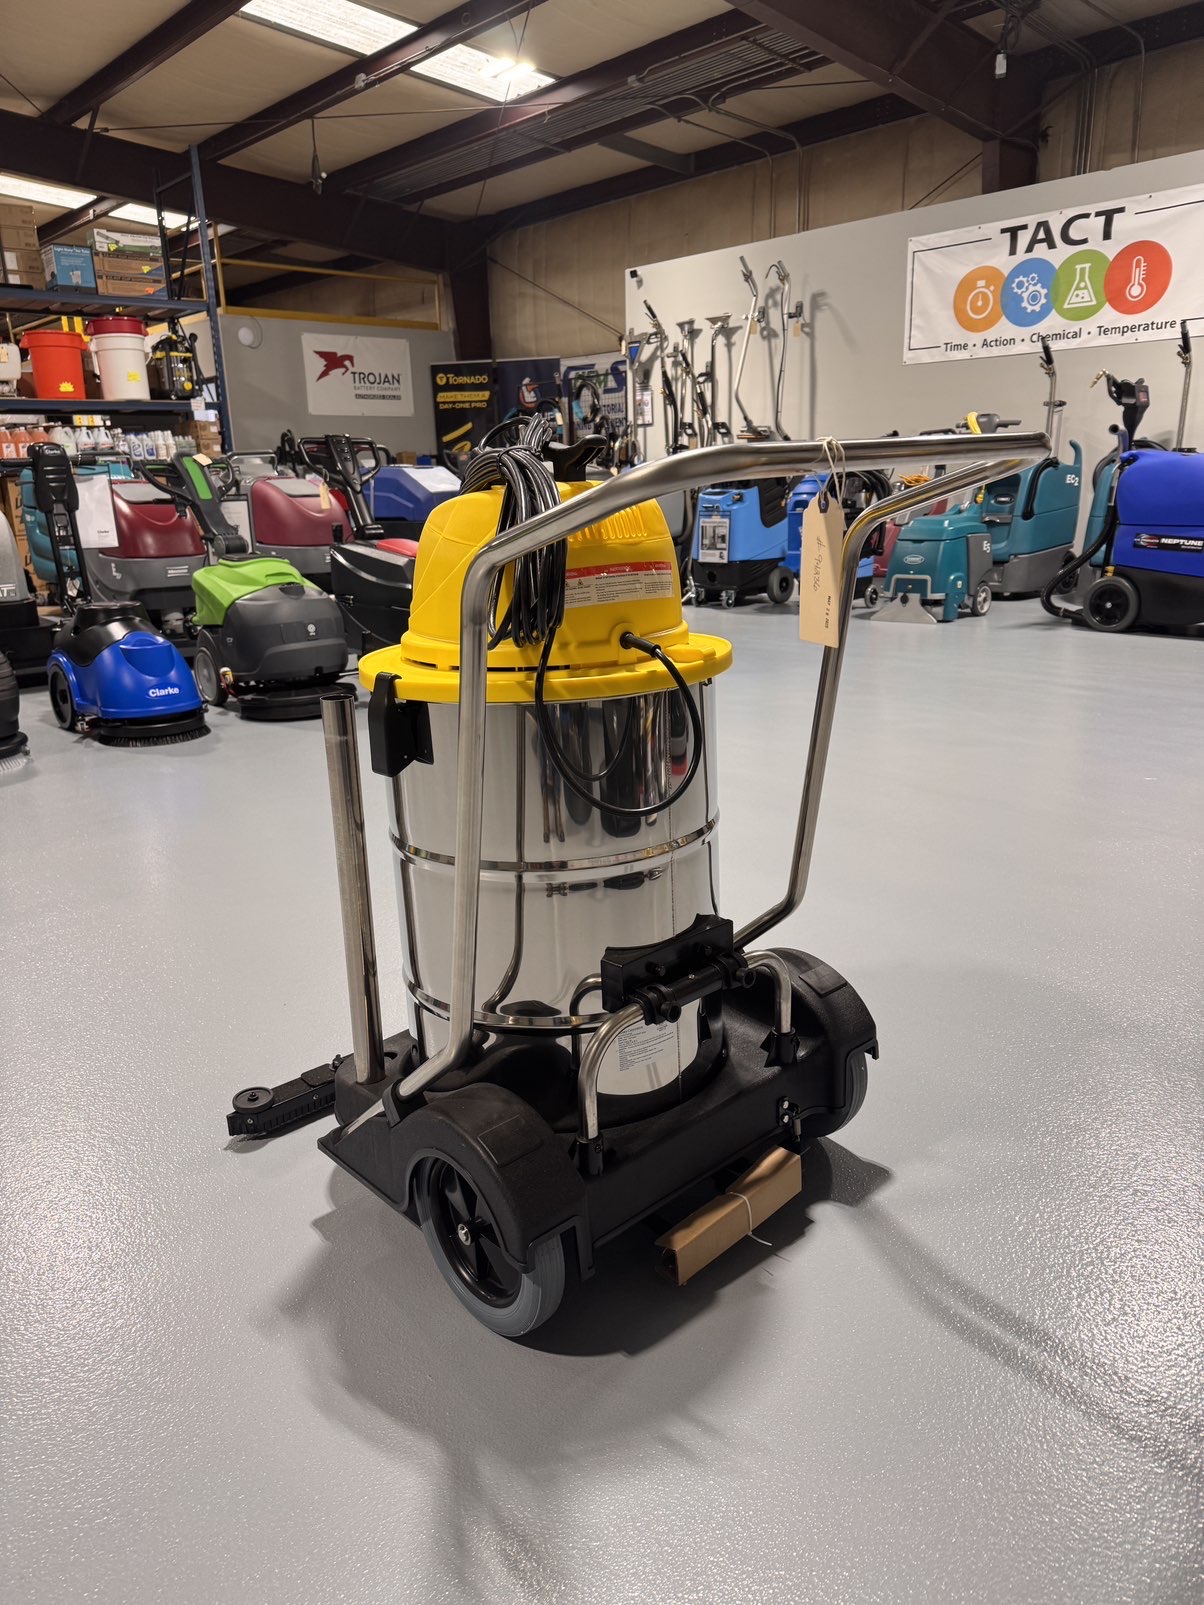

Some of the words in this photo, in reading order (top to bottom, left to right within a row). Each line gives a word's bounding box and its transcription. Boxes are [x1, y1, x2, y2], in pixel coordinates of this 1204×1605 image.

[1000, 206, 1126, 257] TACT
[943, 341, 969, 353] Time
[981, 335, 1016, 349] Action
[1030, 327, 1082, 344] Chemical
[1096, 317, 1177, 338] Temperature
[350, 371, 401, 386] TROJAN
[1160, 538, 1204, 547] NEPTUNE
[148, 686, 180, 698] Clarke
